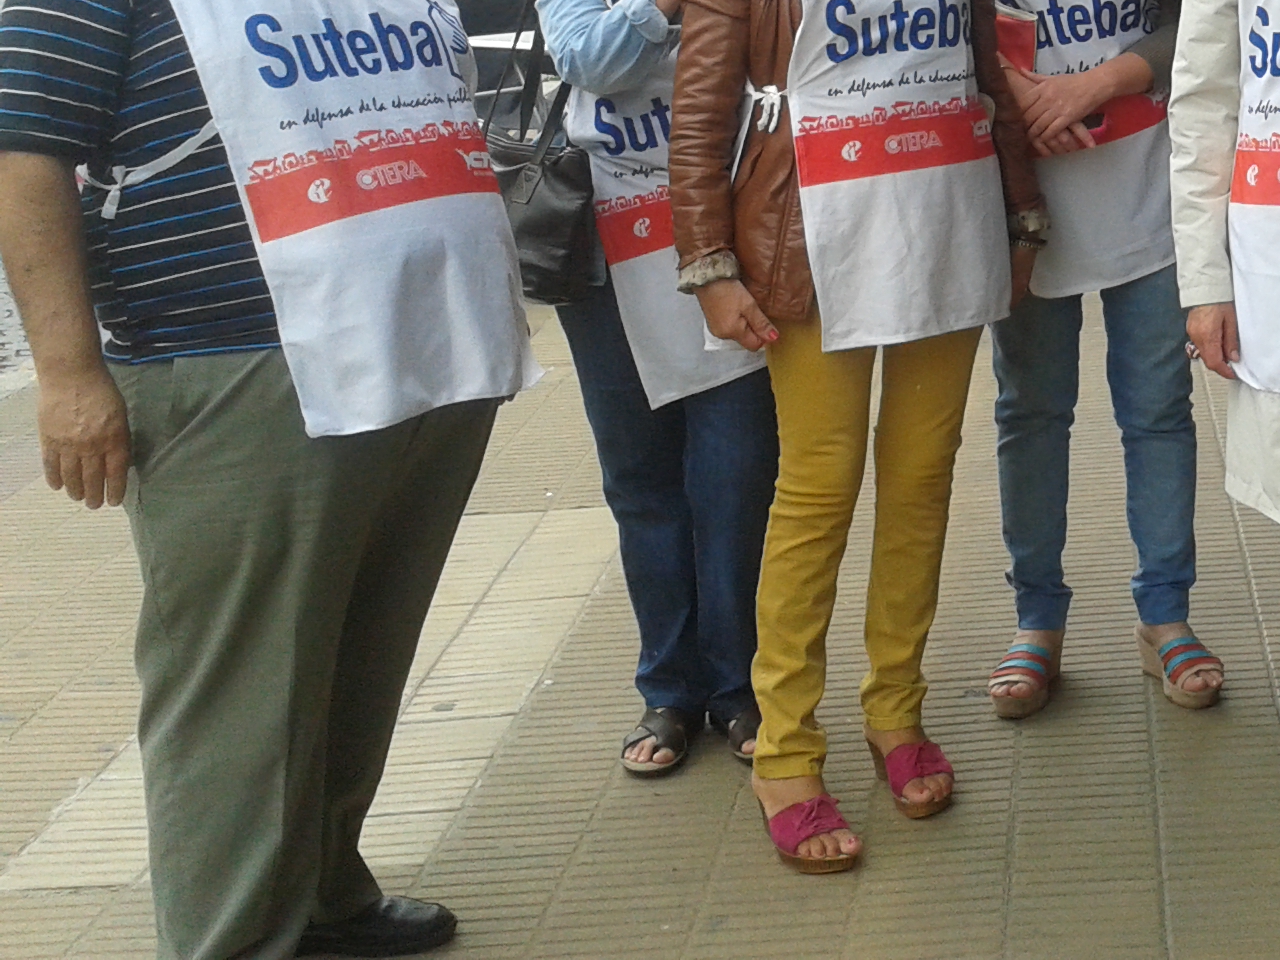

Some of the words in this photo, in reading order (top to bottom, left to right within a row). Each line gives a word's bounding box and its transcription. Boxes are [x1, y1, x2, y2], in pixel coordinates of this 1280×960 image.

[244, 12, 442, 89] Suteba
[827, 88, 843, 97] en
[847, 78, 895, 98] defensa
[898, 72, 910, 86] de
[913, 71, 926, 84] la
[928, 69, 976, 83] educaci
[279, 119, 298, 131] en
[302, 106, 354, 130] defensa
[359, 99, 371, 113] de
[372, 97, 388, 112] la
[391, 93, 446, 109] educación
[594, 97, 671, 156] Sut
[884, 130, 943, 154] CTERA
[356, 160, 428, 190] CTERA
